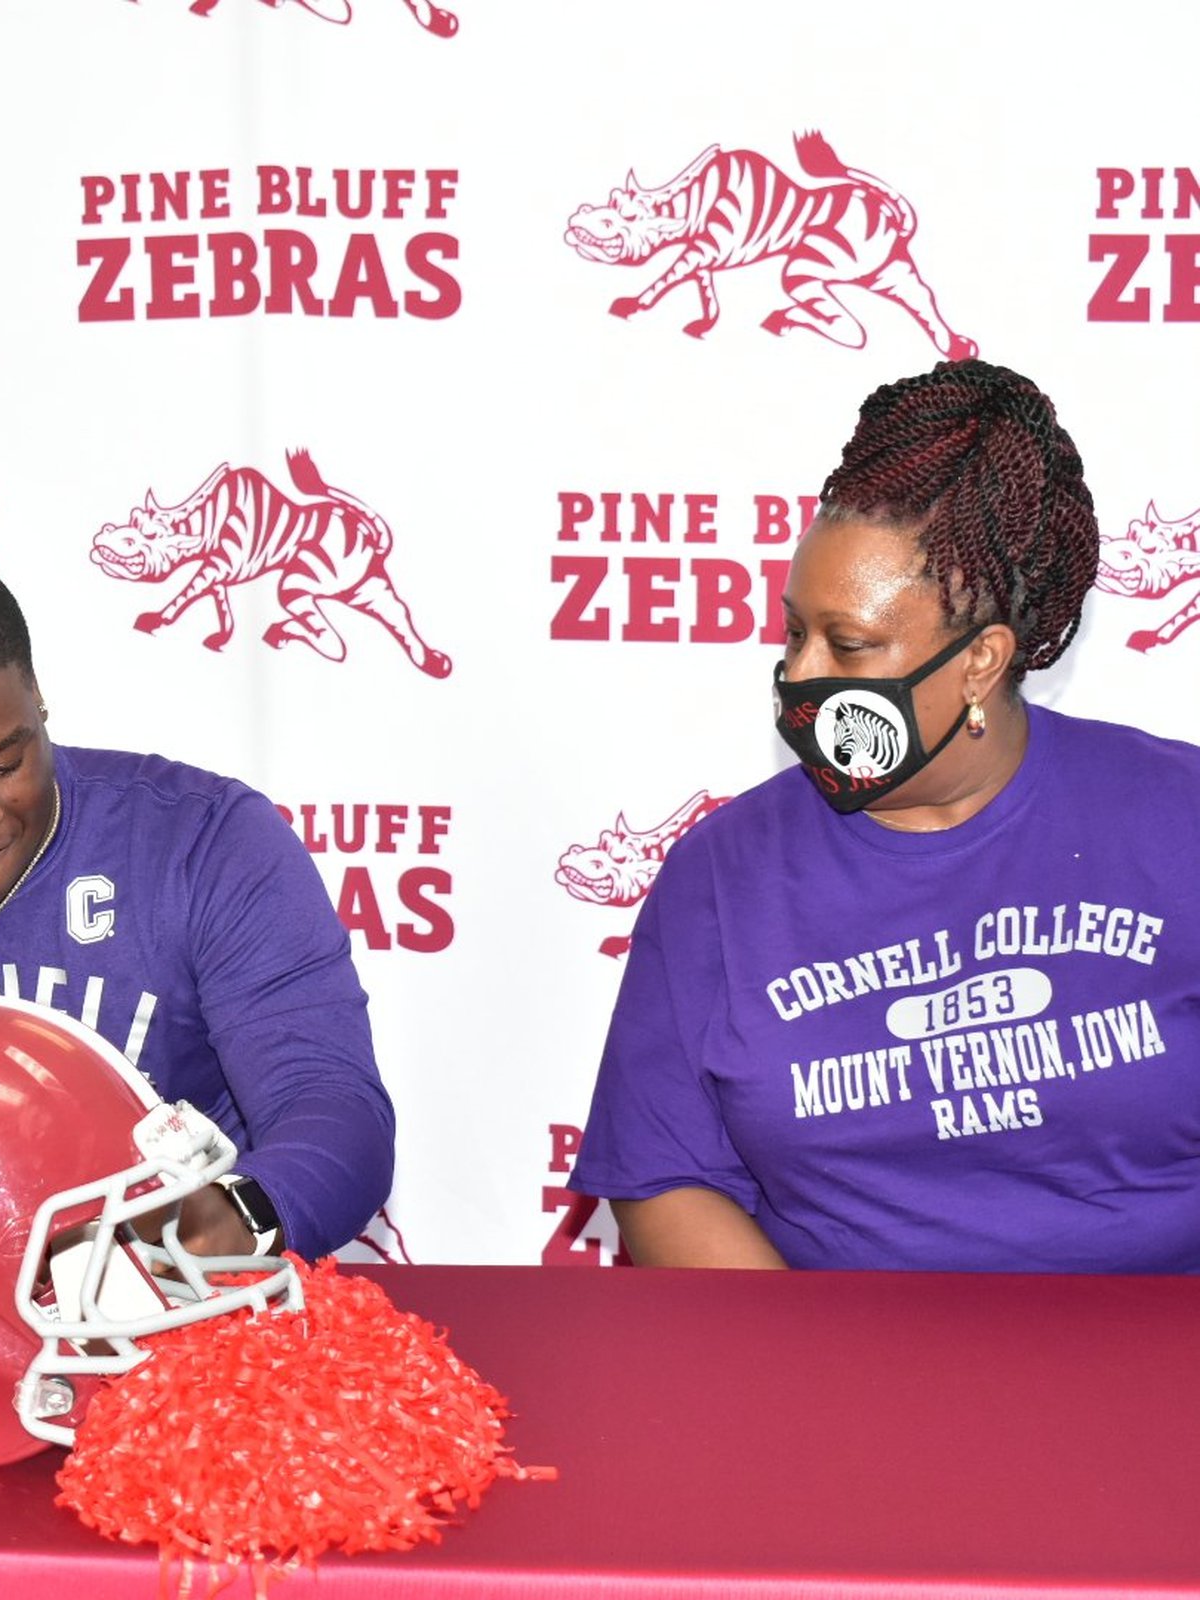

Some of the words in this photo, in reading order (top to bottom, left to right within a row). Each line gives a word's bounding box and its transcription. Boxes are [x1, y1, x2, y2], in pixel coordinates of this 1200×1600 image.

[81, 169, 231, 225] PINE
[257, 165, 459, 220] BLUFF
[1096, 167, 1200, 220] PIN
[76, 229, 463, 323] ZEBRAS
[557, 491, 718, 544] PINE
[766, 929, 962, 1022] CORNELL
[974, 901, 1164, 965] COLLEGE
[924, 974, 1016, 1032] 1853
[790, 1045, 912, 1119] MOUNT
[920, 1019, 1076, 1094] VERNON,
[1071, 999, 1166, 1072] IOWA
[930, 1088, 1044, 1140] RAMS
